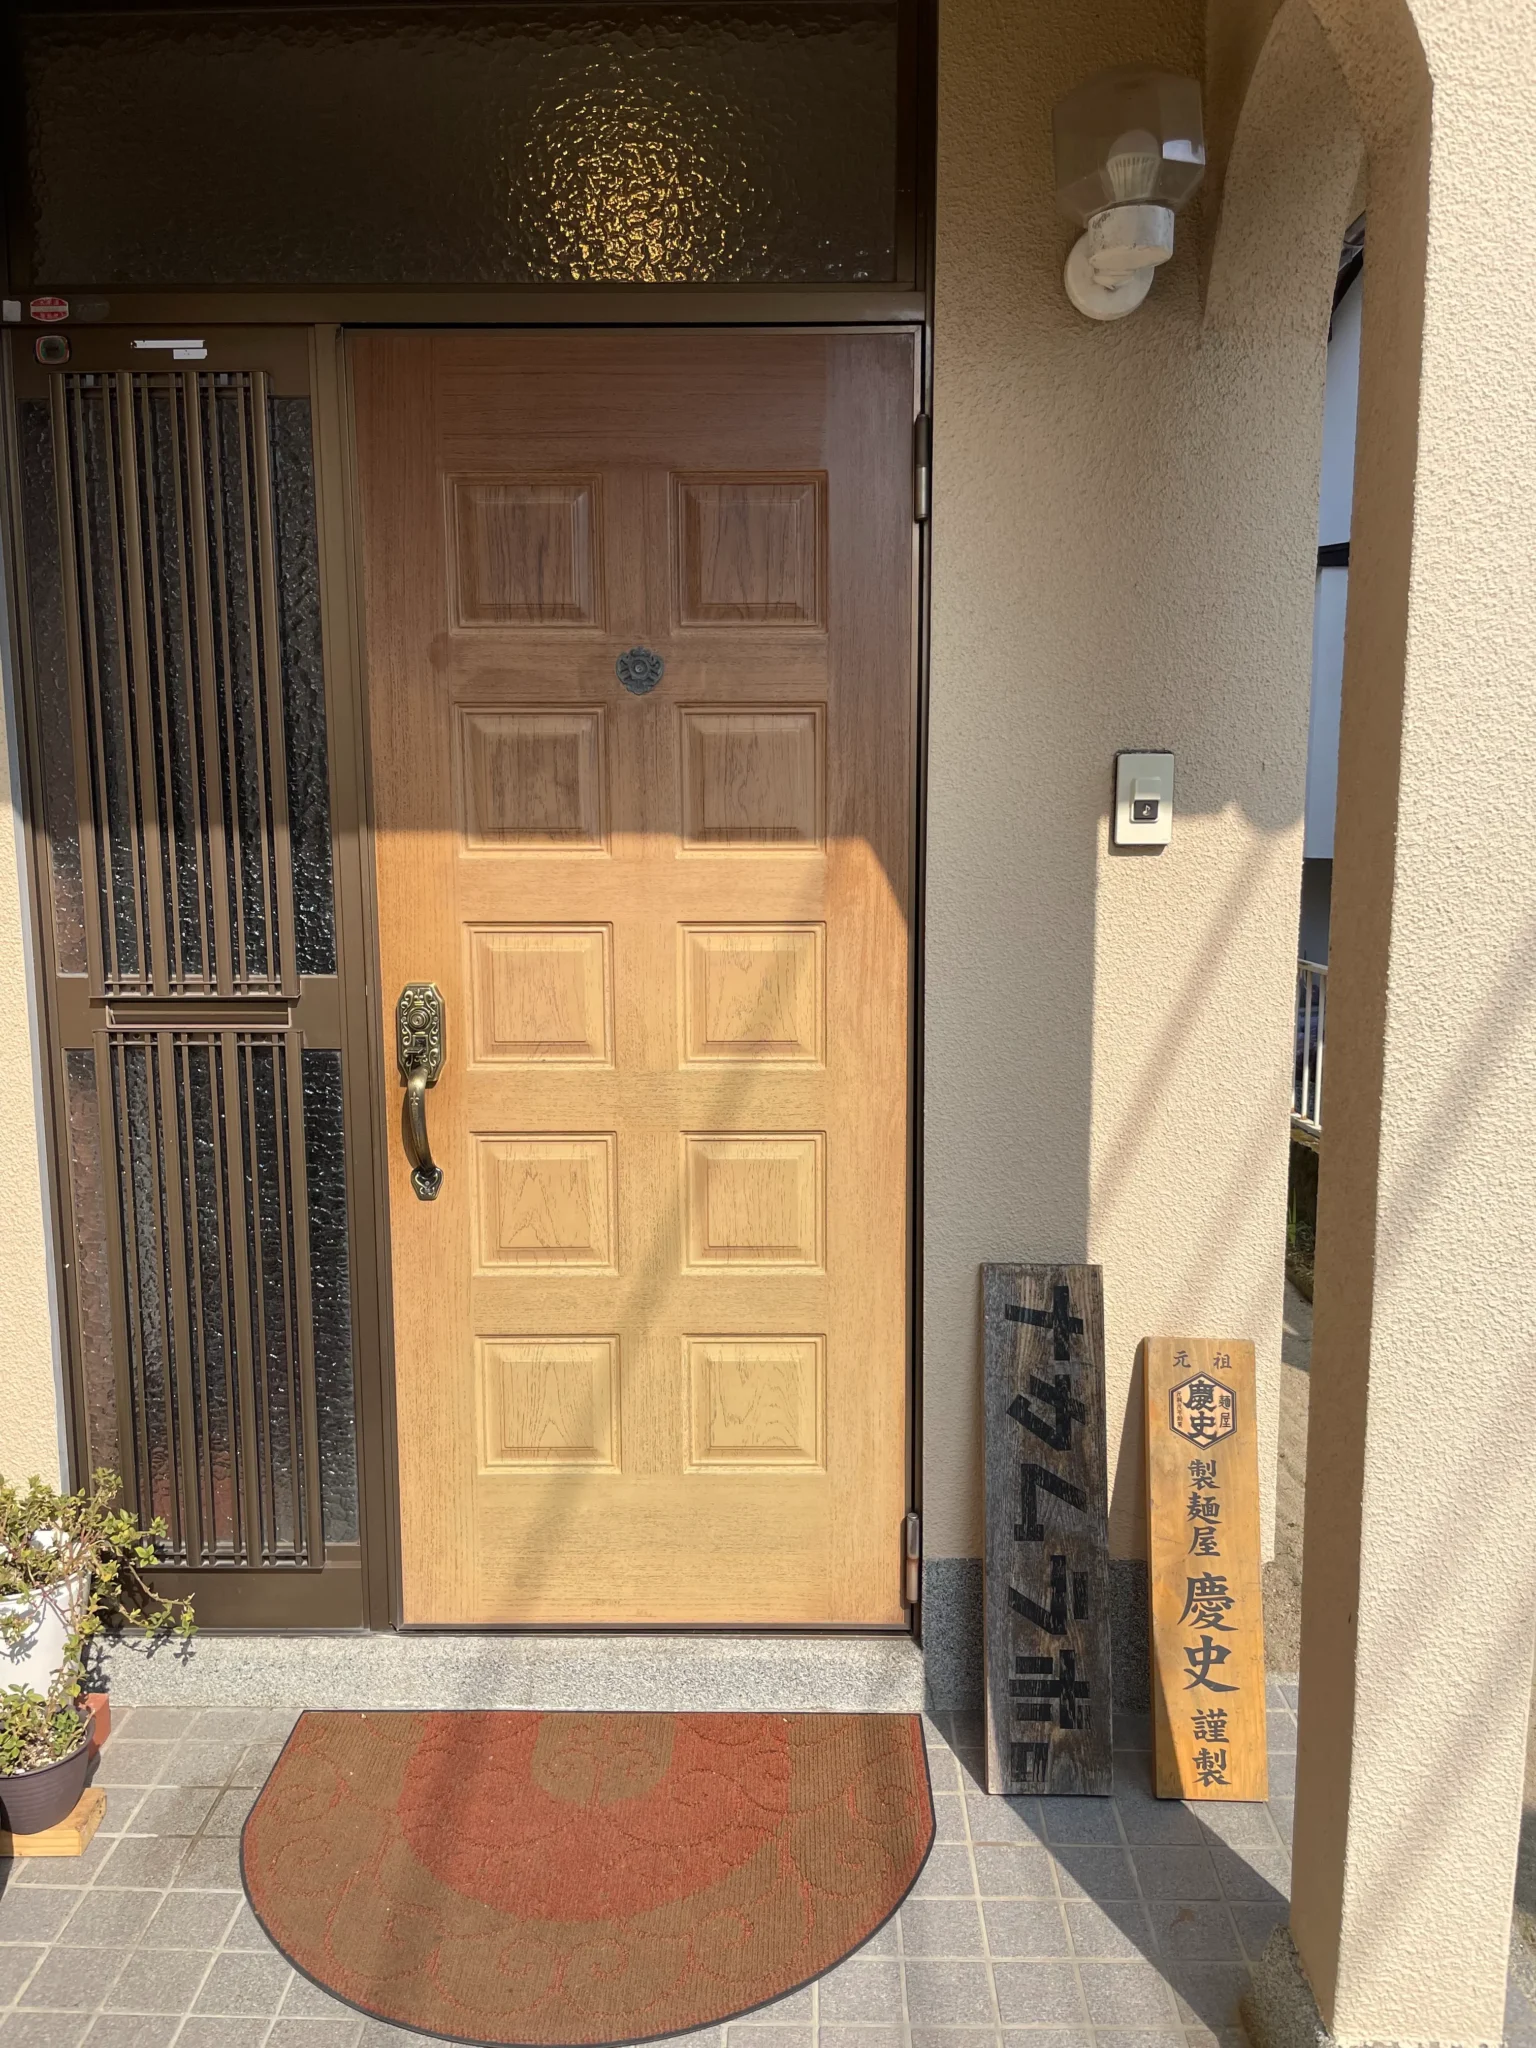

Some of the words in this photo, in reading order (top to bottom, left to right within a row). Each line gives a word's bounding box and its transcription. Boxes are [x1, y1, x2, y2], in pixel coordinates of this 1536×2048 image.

[1173, 1350, 1232, 1369] 元祖
[1183, 1380, 1217, 1441] 慶史
[1218, 1394, 1231, 1428] 麺屋
[1186, 1458, 1222, 1557] 製麺屋
[1177, 1571, 1240, 1693] 慶史
[1190, 1708, 1232, 1788] 謹製
